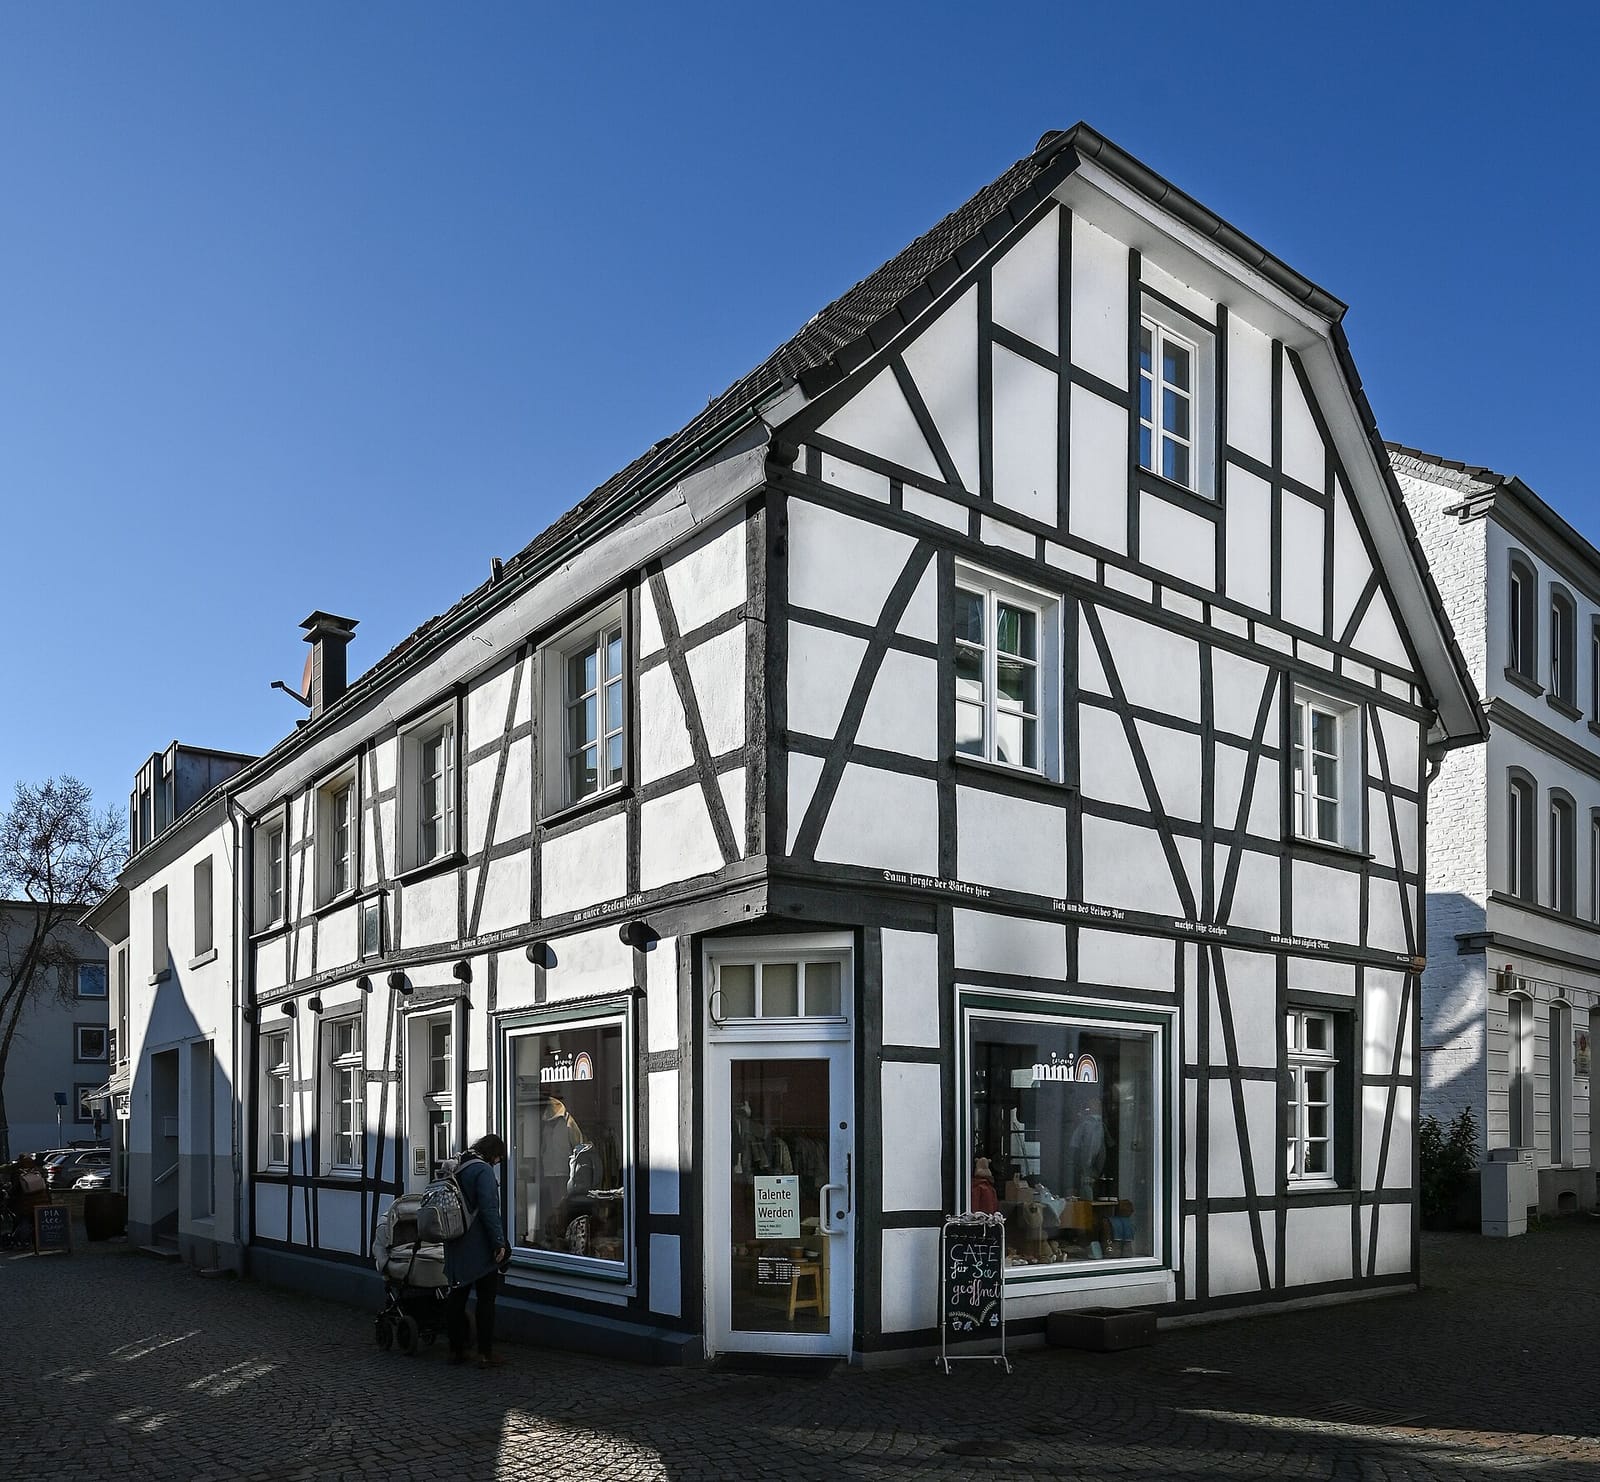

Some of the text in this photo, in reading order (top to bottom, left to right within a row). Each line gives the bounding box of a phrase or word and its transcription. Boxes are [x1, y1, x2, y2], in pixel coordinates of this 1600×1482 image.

[883, 870, 906, 883] Dann
[934, 878, 947, 889] der
[975, 886, 991, 897] hier
[540, 1052, 573, 1083] mini
[1032, 1051, 1075, 1082] mini
[757, 1188, 792, 1200] Talente
[758, 1206, 794, 1218] Werden
[950, 1238, 1001, 1263] CAFÉ
[950, 1260, 998, 1280] für Sie
[951, 1279, 1001, 1307] geöffnet
